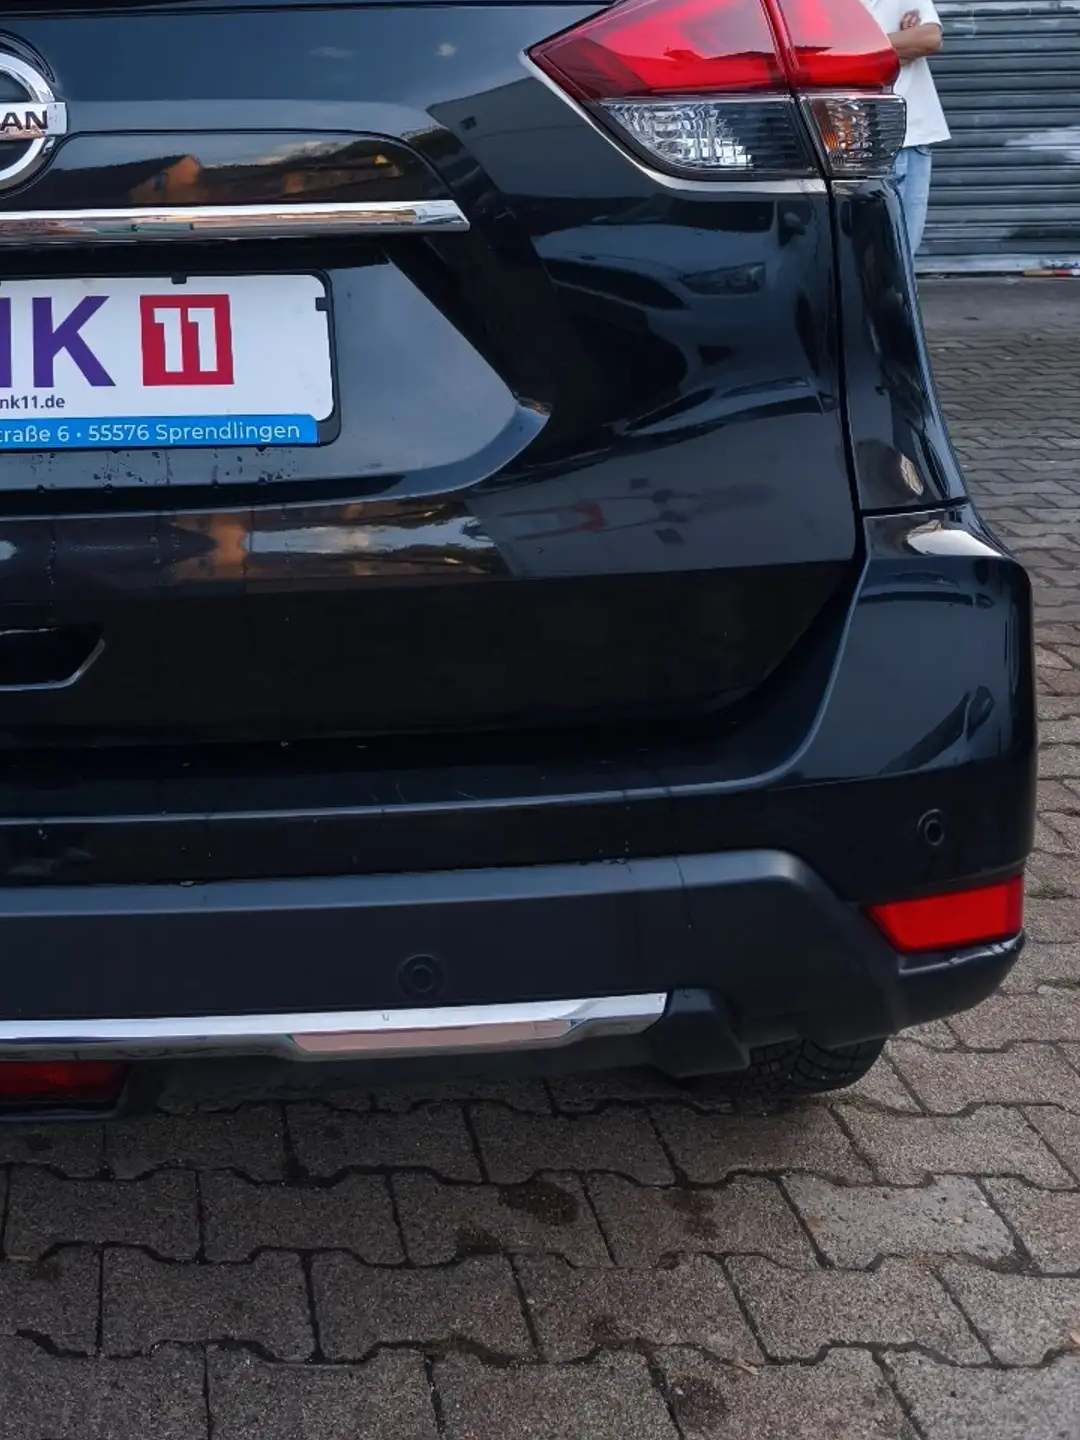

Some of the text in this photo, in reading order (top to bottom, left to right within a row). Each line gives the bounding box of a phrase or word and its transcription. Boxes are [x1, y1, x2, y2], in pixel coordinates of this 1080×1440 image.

[153, 307, 219, 373] 11
[57, 426, 70, 442] 6
[88, 424, 150, 442] 55576
[156, 421, 301, 442] Sprendlingen
